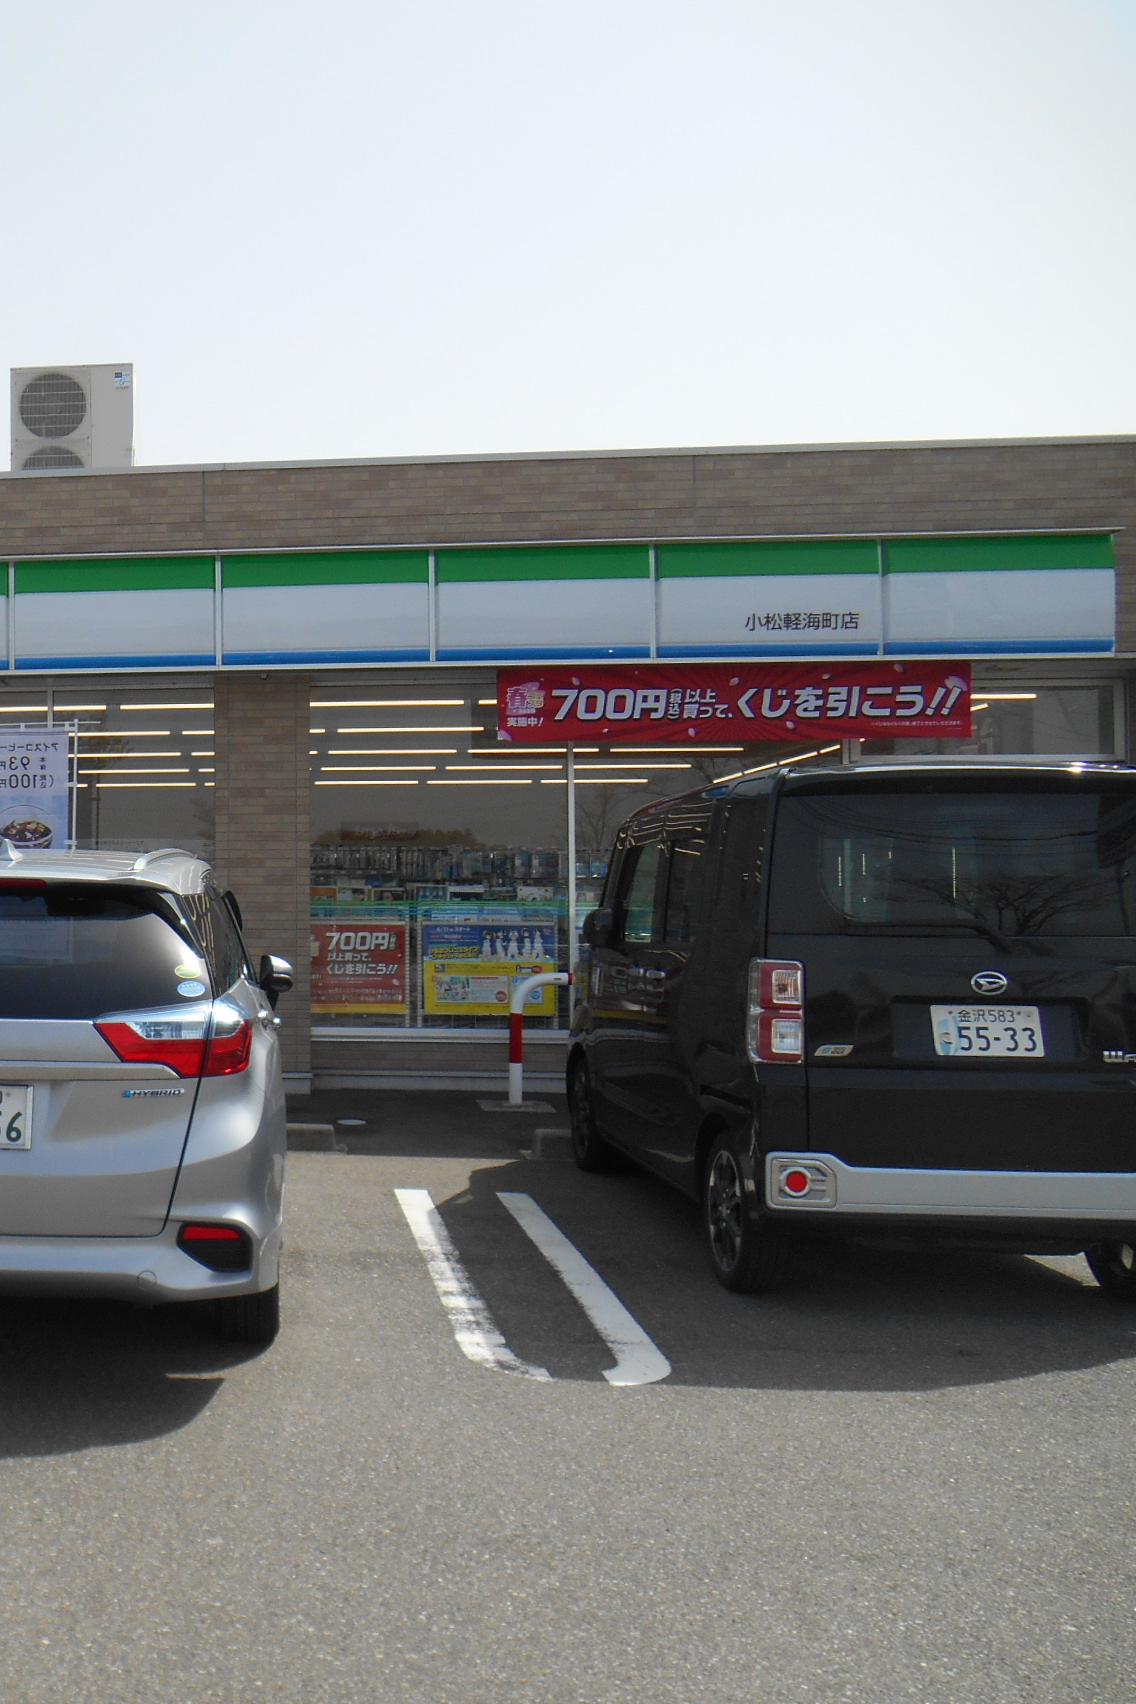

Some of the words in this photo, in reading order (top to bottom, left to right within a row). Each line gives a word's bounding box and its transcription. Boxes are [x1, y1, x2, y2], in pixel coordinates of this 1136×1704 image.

[744, 612, 860, 631] 小松軽海町店
[551, 688, 668, 720] 700円
[737, 686, 962, 718] くじを引こう!!
[326, 932, 390, 950] 700円
[957, 1009, 1015, 1024] 金沢583
[958, 1026, 1037, 1052] 55-33
[131, 1089, 182, 1097] HYBRID
